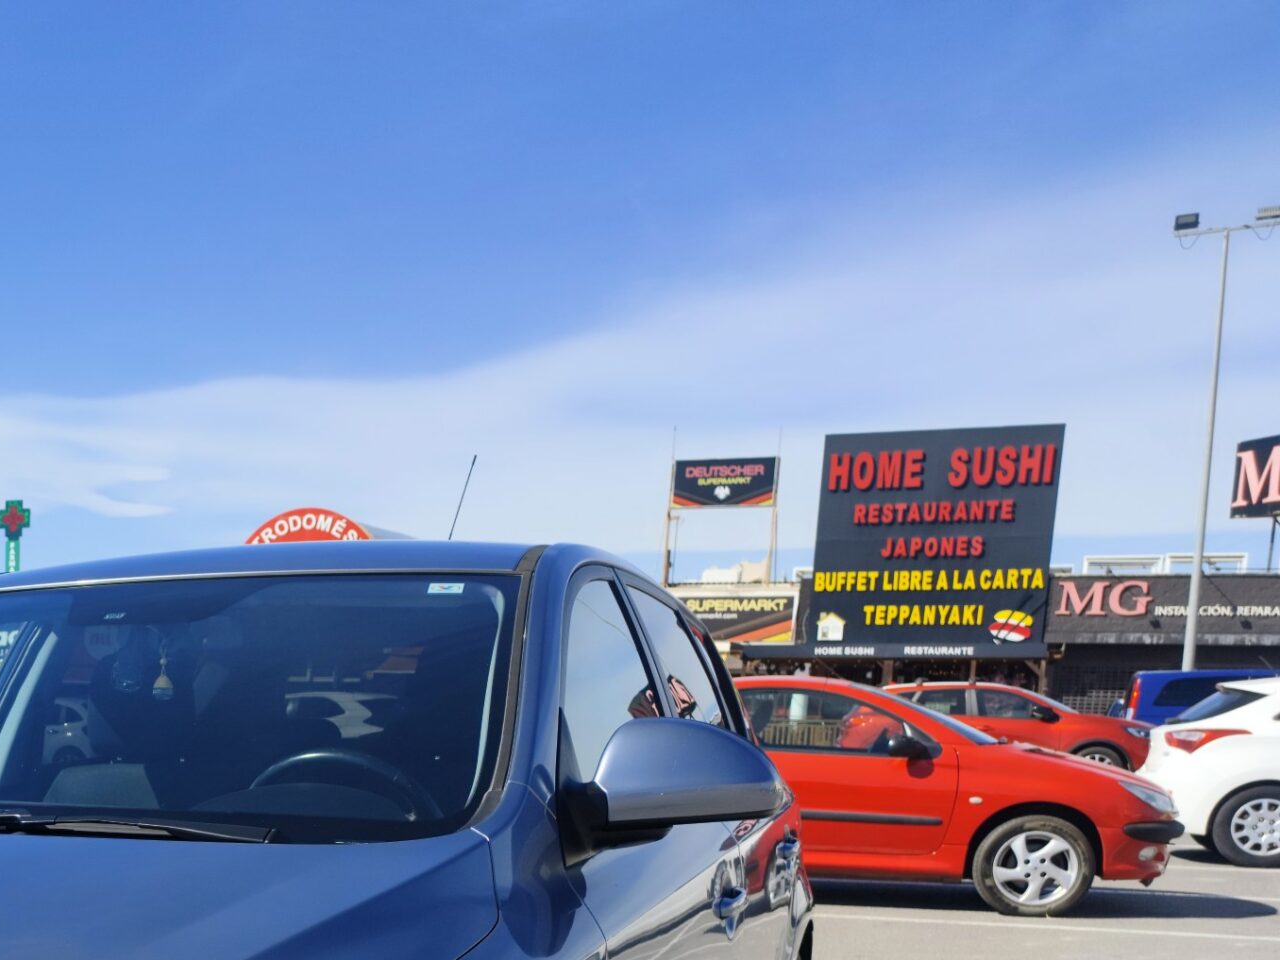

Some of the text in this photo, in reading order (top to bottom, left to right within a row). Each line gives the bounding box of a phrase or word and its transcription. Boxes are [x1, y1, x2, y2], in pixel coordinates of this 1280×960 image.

[685, 464, 765, 478] DEUTSCHER
[827, 443, 1057, 491] HOME SUSHI
[697, 477, 752, 486] SUPERMARKT
[853, 499, 1015, 524] RESTAURANTE
[251, 513, 362, 544] RODOMÉS
[880, 536, 984, 558] JAPONES
[814, 568, 1044, 592] BUFFET LIBRE A LA CARTA
[686, 598, 788, 612] SUPERMARKT
[1055, 580, 1154, 617] MG
[863, 604, 985, 626] TEPPANYAKI
[1154, 603, 1233, 617] INSTACIÓN,
[814, 646, 974, 655] HOME SUSHI RESTAURANTE
